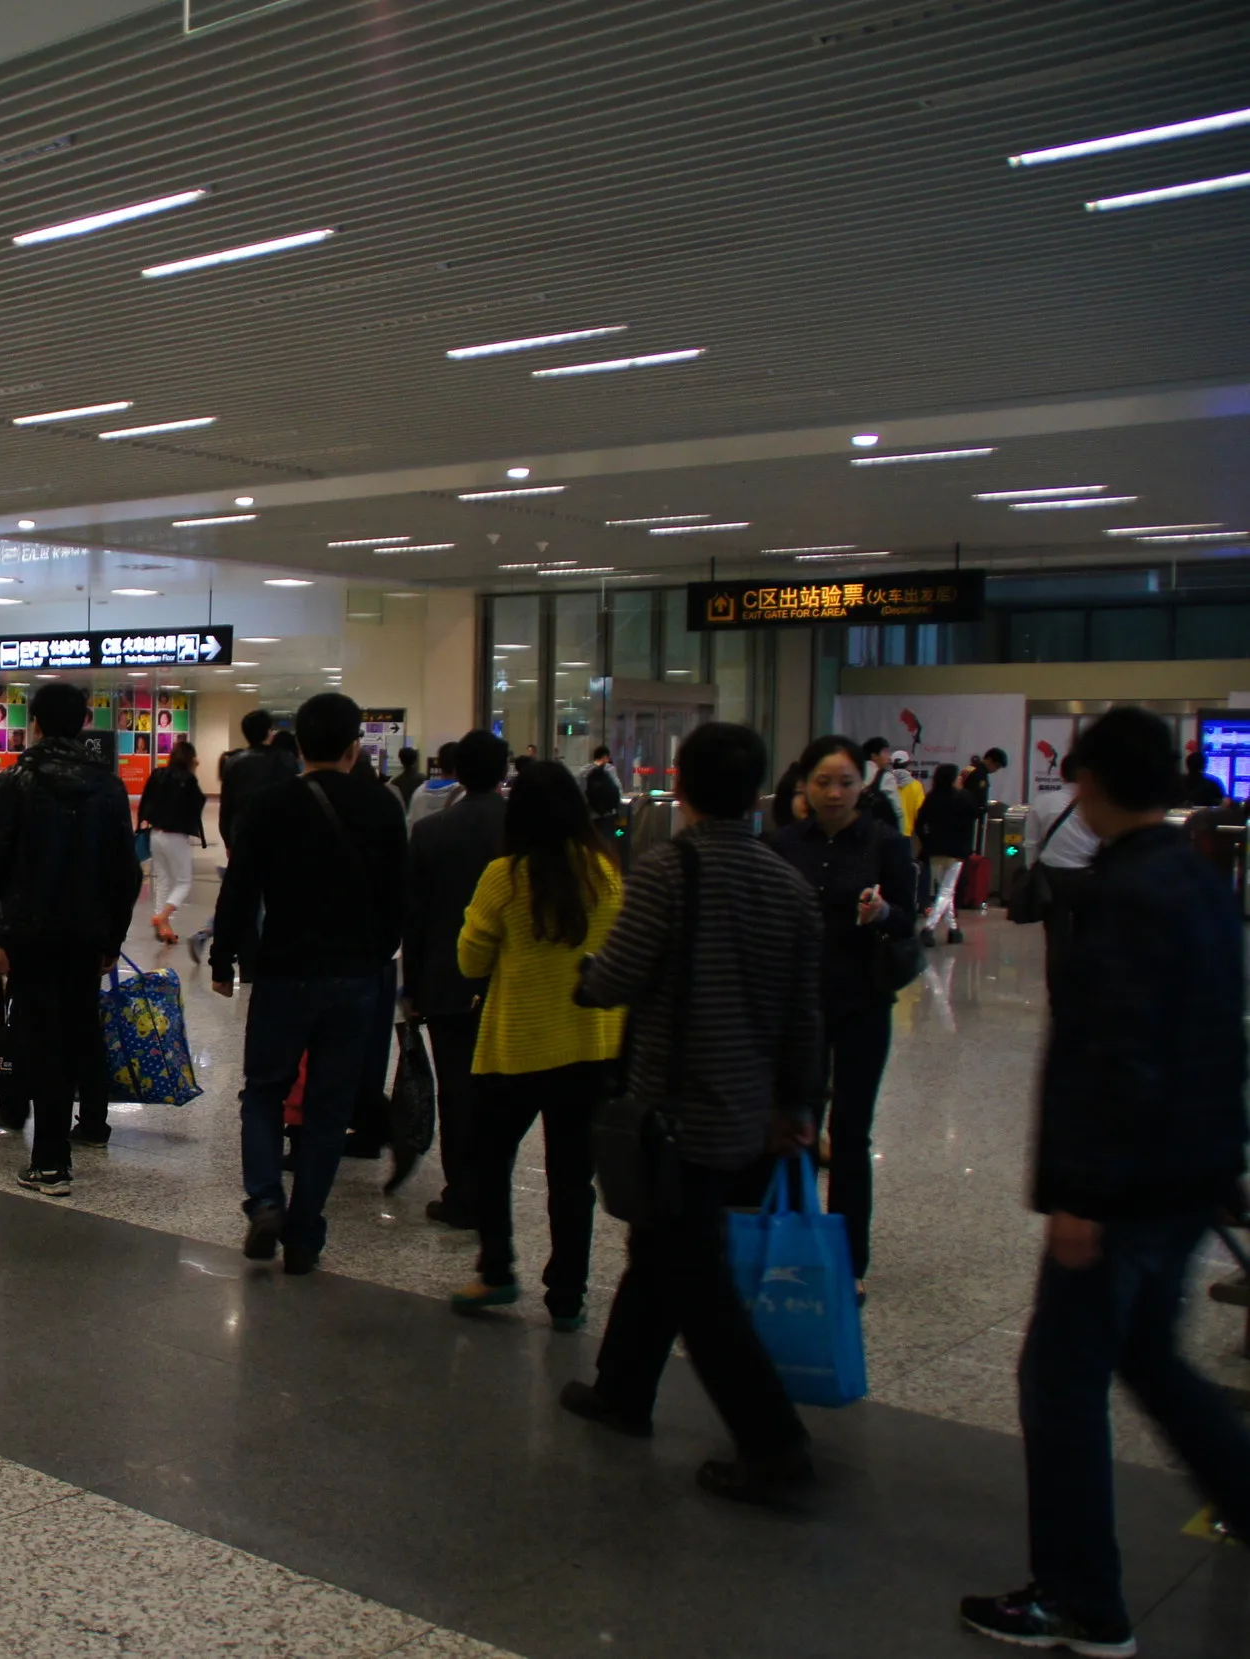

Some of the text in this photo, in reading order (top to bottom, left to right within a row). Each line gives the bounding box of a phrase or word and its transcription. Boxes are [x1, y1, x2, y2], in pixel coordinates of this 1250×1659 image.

[742, 583, 865, 610] C区出站验票
[741, 607, 848, 620] EXIT GATE FOR C AREA
